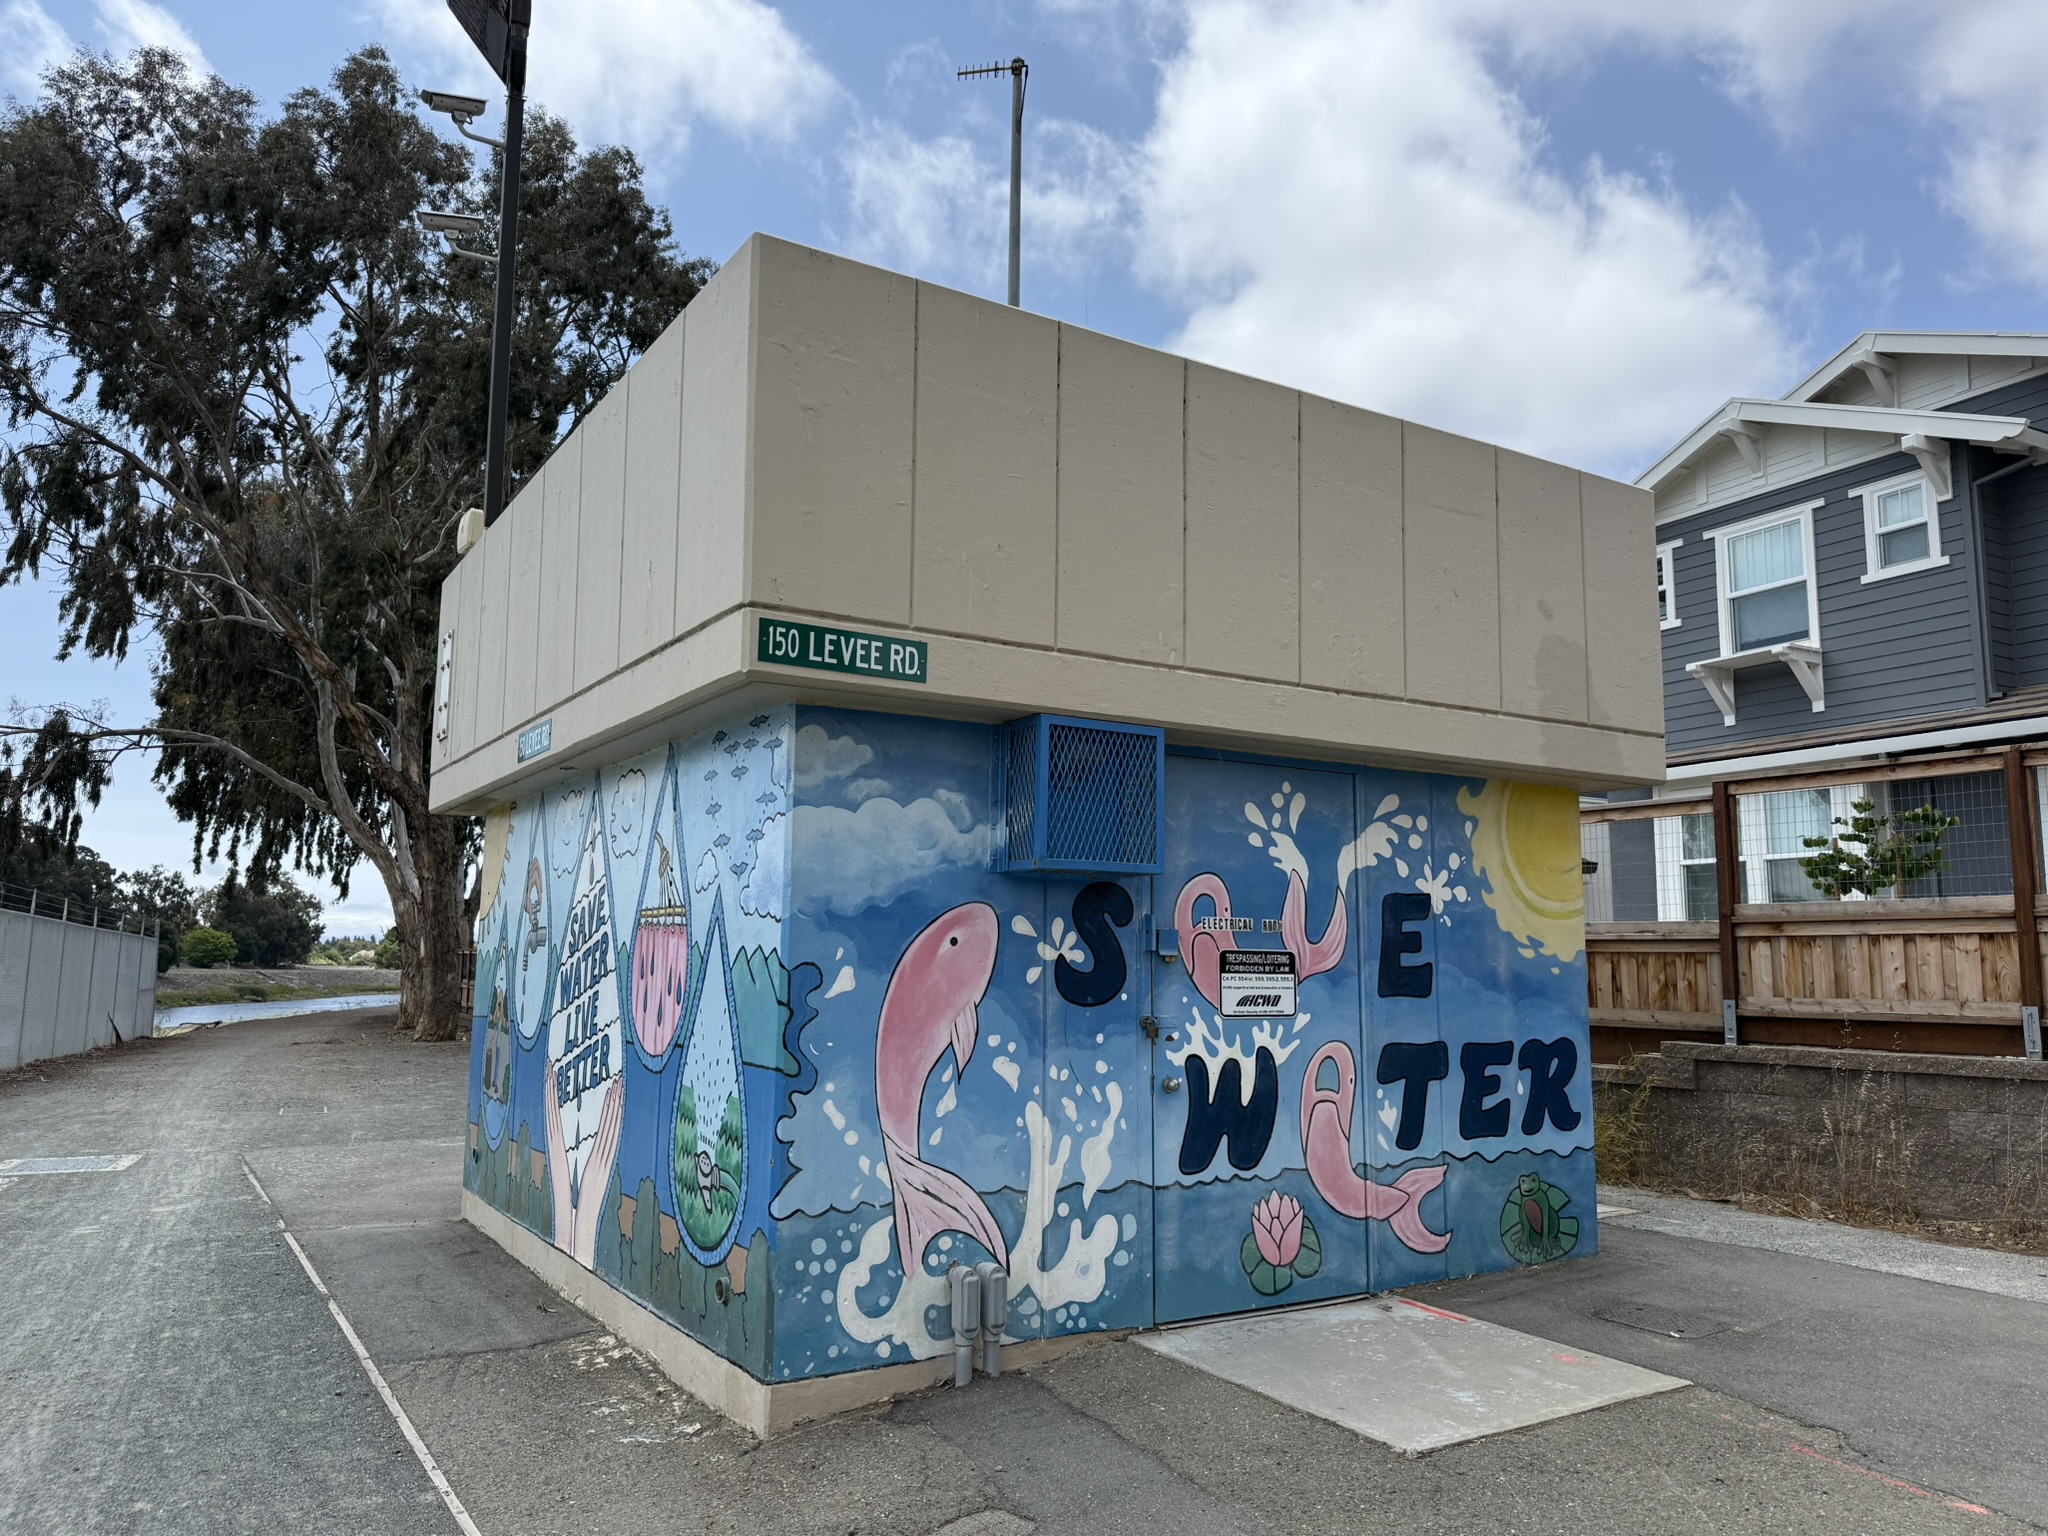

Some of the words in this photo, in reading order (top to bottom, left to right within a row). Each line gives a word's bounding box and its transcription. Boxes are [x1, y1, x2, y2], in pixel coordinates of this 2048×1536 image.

[768, 625, 800, 658] 150
[808, 631, 883, 670] LEVEE
[889, 643, 921, 676] RD.
[569, 883, 606, 956] SAVE
[1202, 917, 1253, 931] ELECTRICAL
[560, 931, 610, 1010] WATER
[1225, 953, 1290, 965] TRESPASSING/LOITERING
[1225, 964, 1264, 972] FORBIDDEN
[1275, 965, 1290, 973] LAW
[564, 990, 600, 1055] LIVE
[1236, 994, 1282, 1007] ACWD
[557, 1033, 611, 1108] BETTER
[1178, 1036, 1582, 1216] WATER
